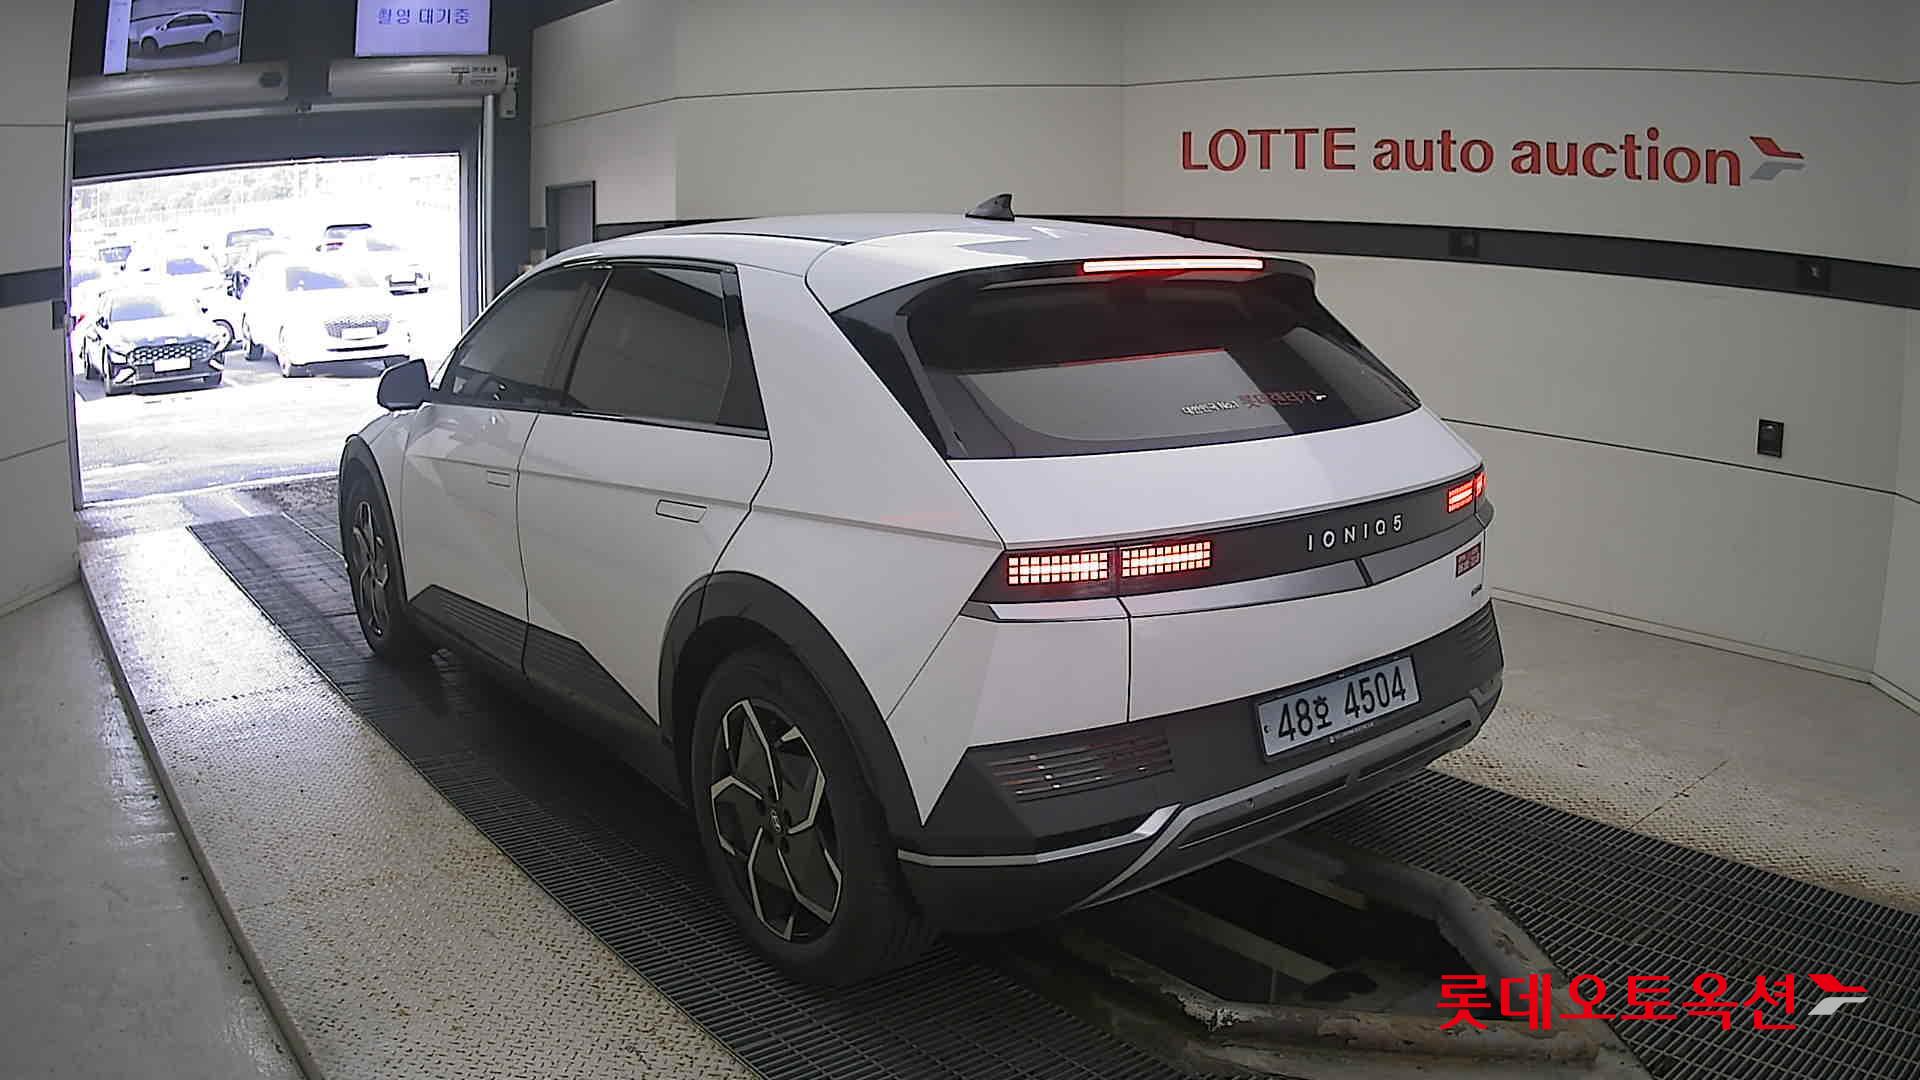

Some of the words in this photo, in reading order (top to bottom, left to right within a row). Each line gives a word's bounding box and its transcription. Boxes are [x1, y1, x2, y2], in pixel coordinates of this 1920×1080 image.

[418, 7, 471, 25] 대기중
[1182, 128, 1356, 171] LOTTE
[1372, 129, 1494, 173] auto
[1511, 127, 1743, 186] auction
[1278, 695, 1332, 741] 48호
[1344, 666, 1406, 718] 4504
